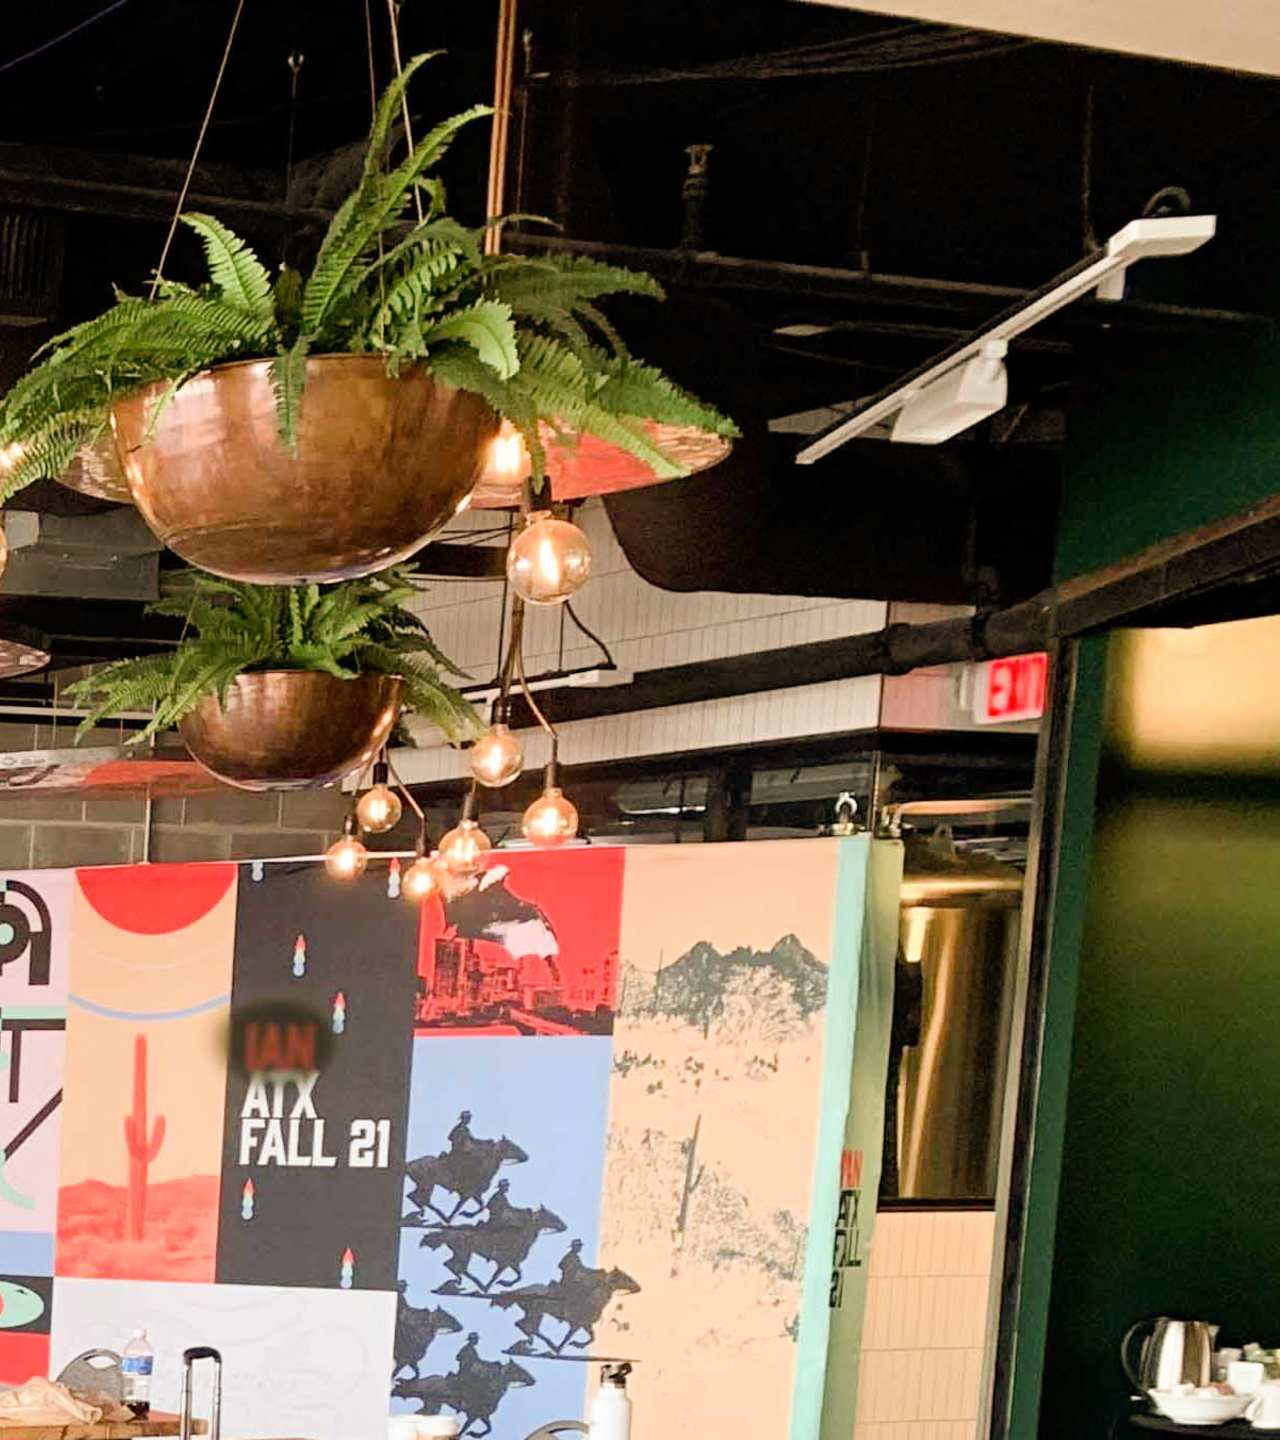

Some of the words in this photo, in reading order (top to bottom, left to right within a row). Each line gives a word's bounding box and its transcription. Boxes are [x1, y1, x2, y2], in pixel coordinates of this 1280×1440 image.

[987, 657, 1046, 717] EXIT
[240, 1071, 321, 1119] ATX
[239, 1118, 338, 1167] FALL
[348, 1119, 391, 1169] 21
